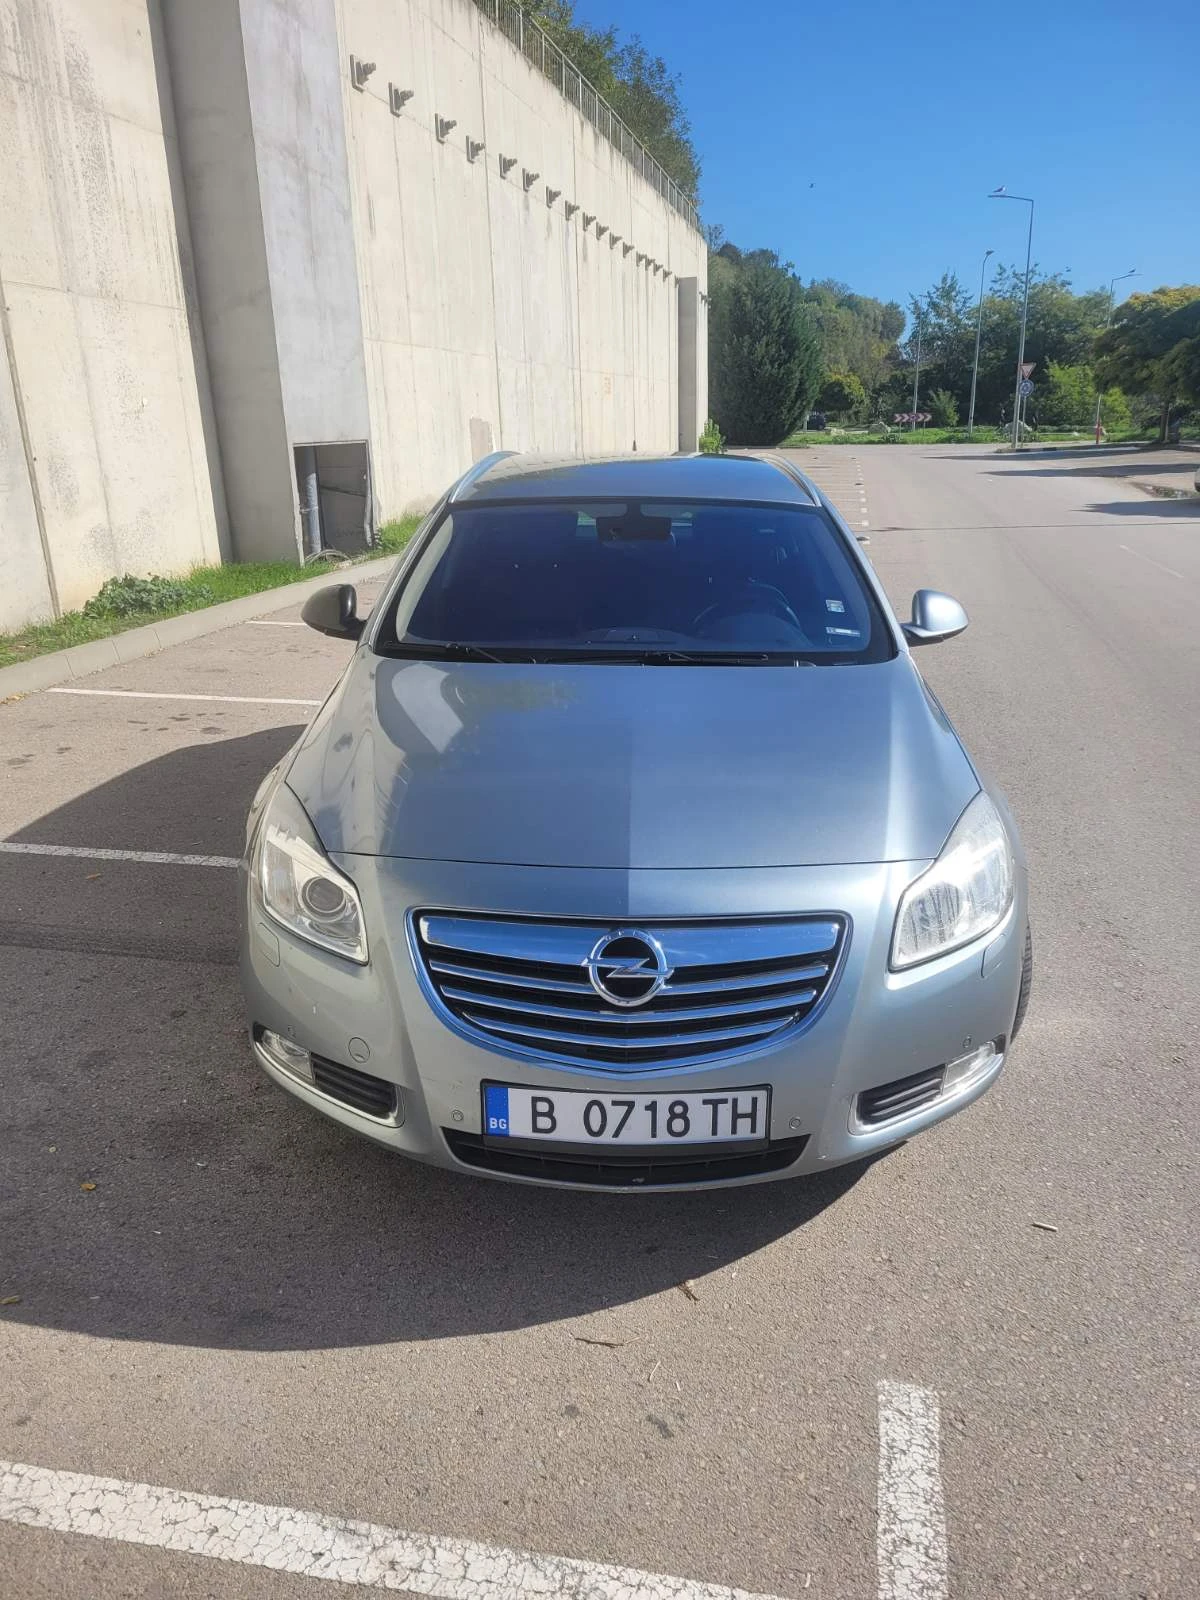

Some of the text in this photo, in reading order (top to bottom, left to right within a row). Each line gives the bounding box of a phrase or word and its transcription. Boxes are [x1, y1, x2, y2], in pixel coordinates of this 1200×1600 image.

[489, 1117, 507, 1129] BG
[531, 1096, 758, 1139] B 0718 TH
